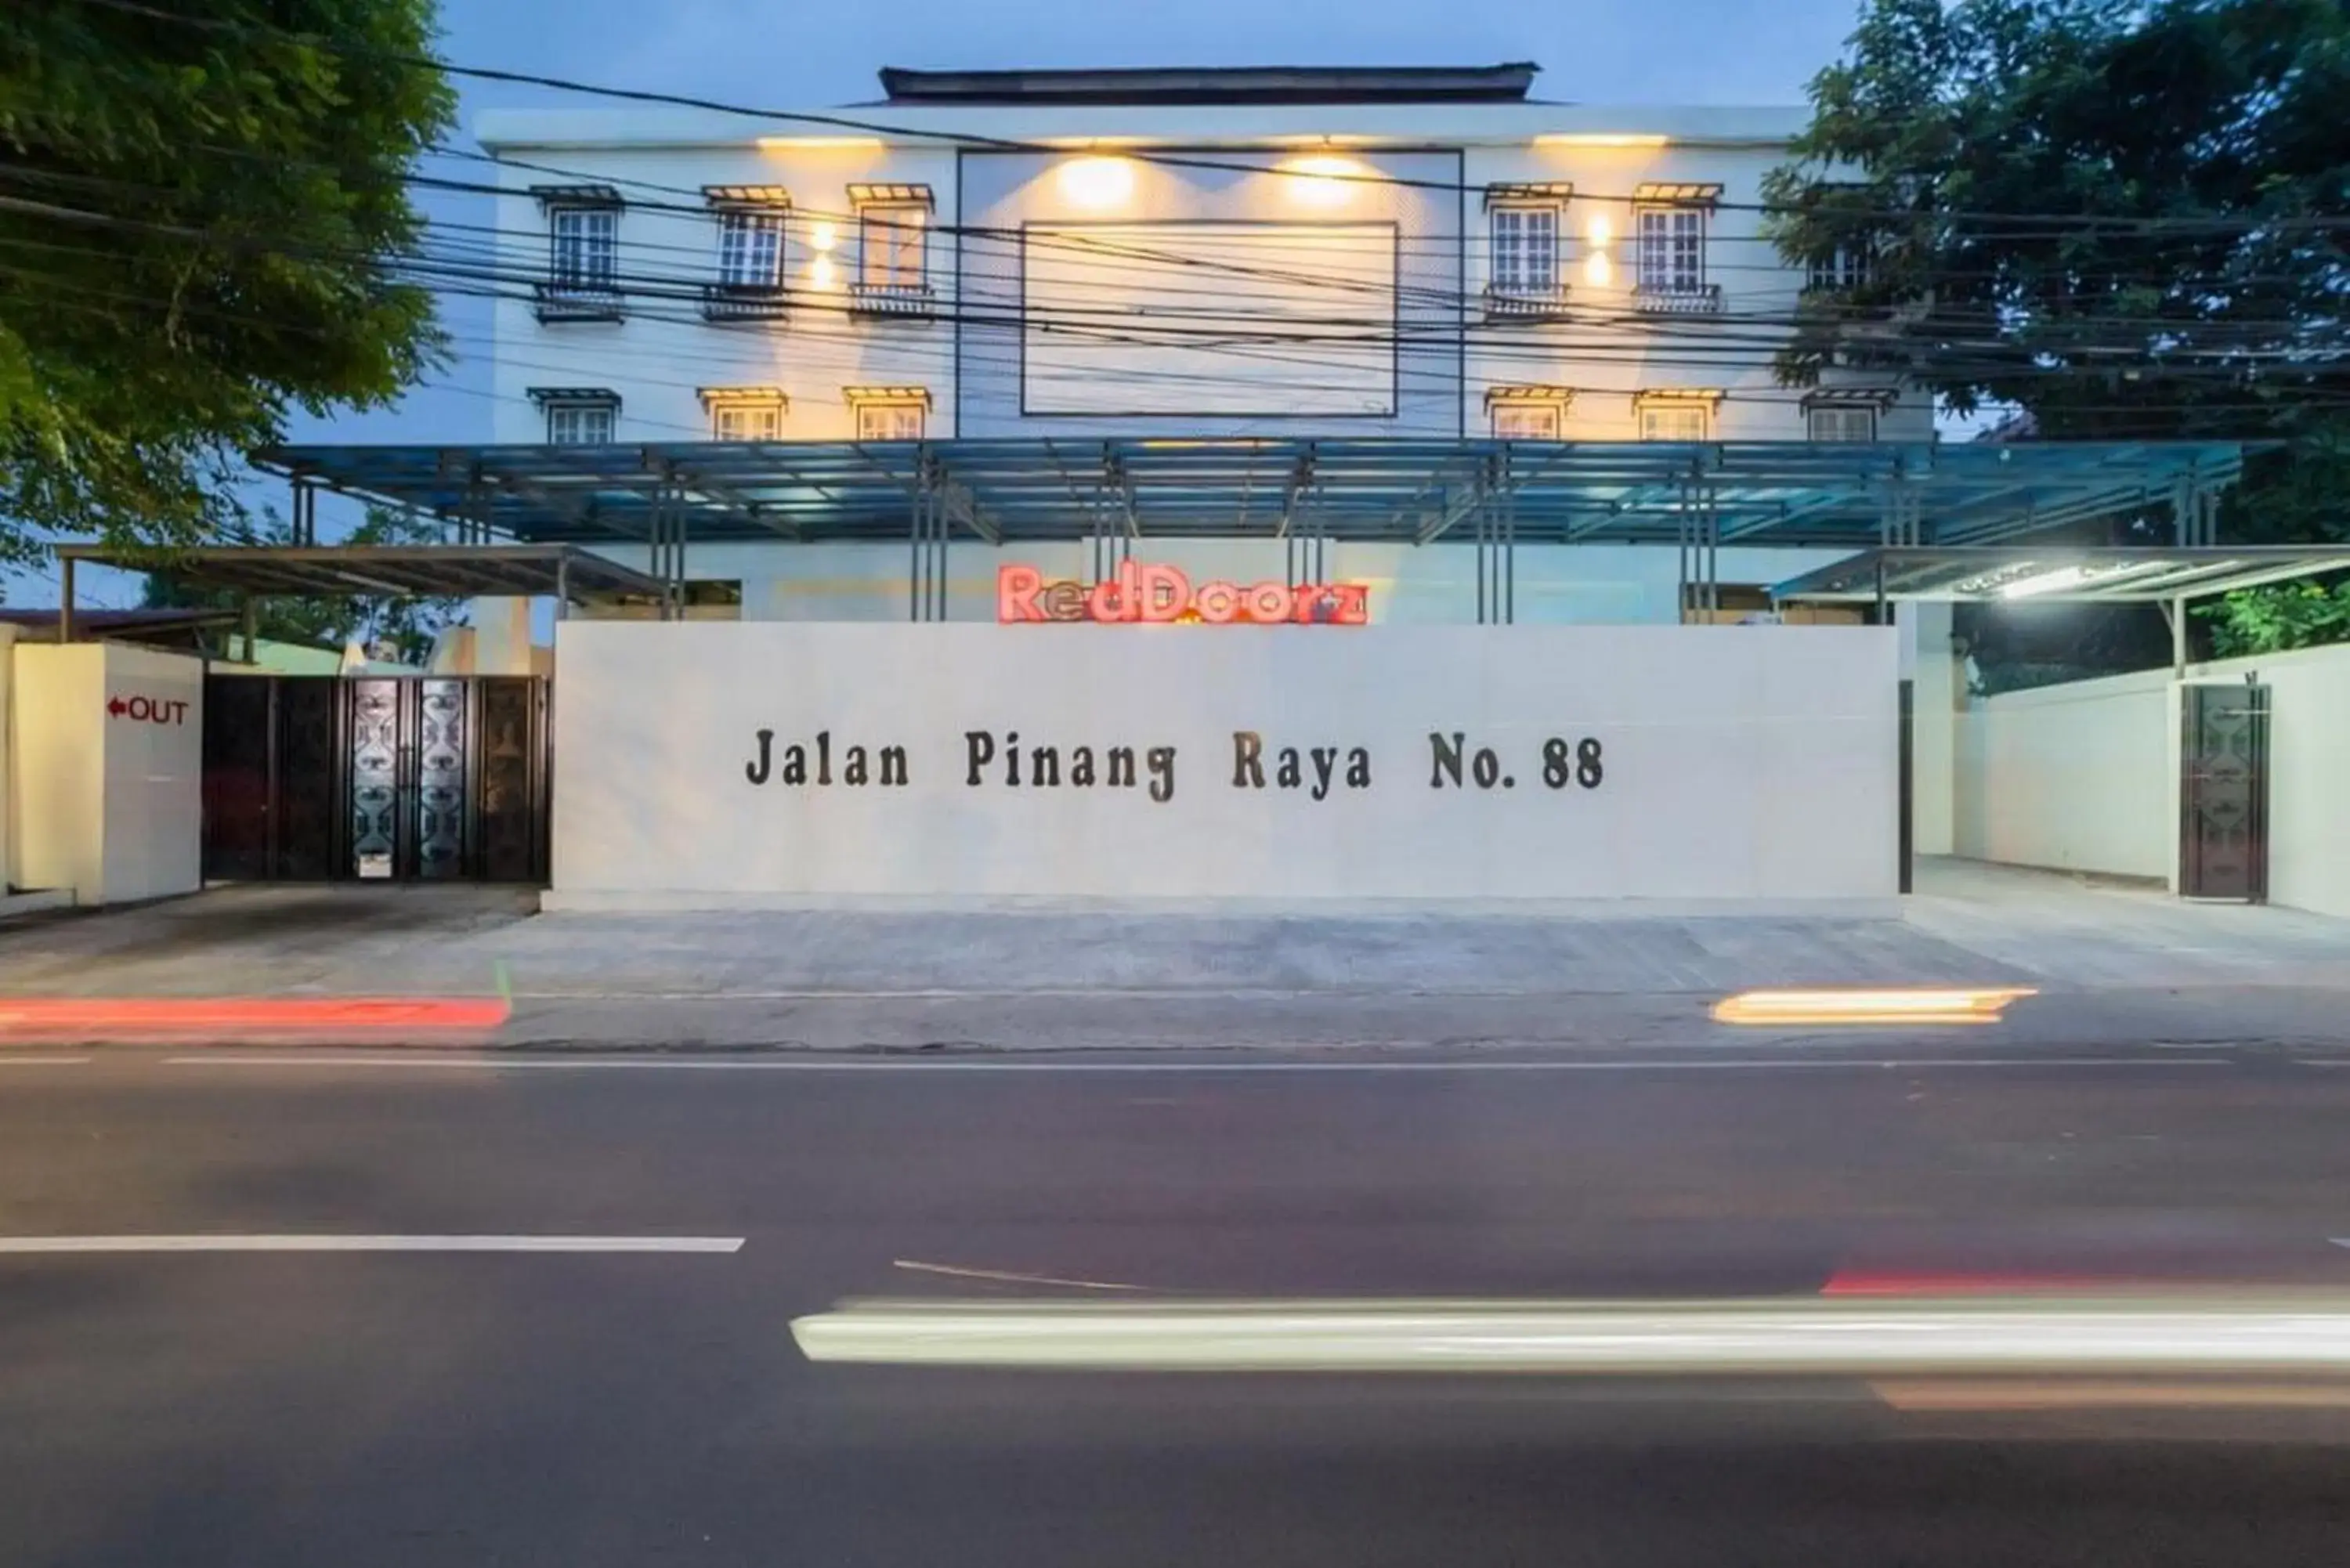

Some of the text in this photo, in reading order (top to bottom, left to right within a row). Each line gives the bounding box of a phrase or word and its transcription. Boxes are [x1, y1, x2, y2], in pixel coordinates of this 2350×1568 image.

[998, 558, 1368, 625] RedDoorz
[128, 696, 189, 725] OUT
[745, 728, 1603, 803] Jalan Pinang Raya No. 88
